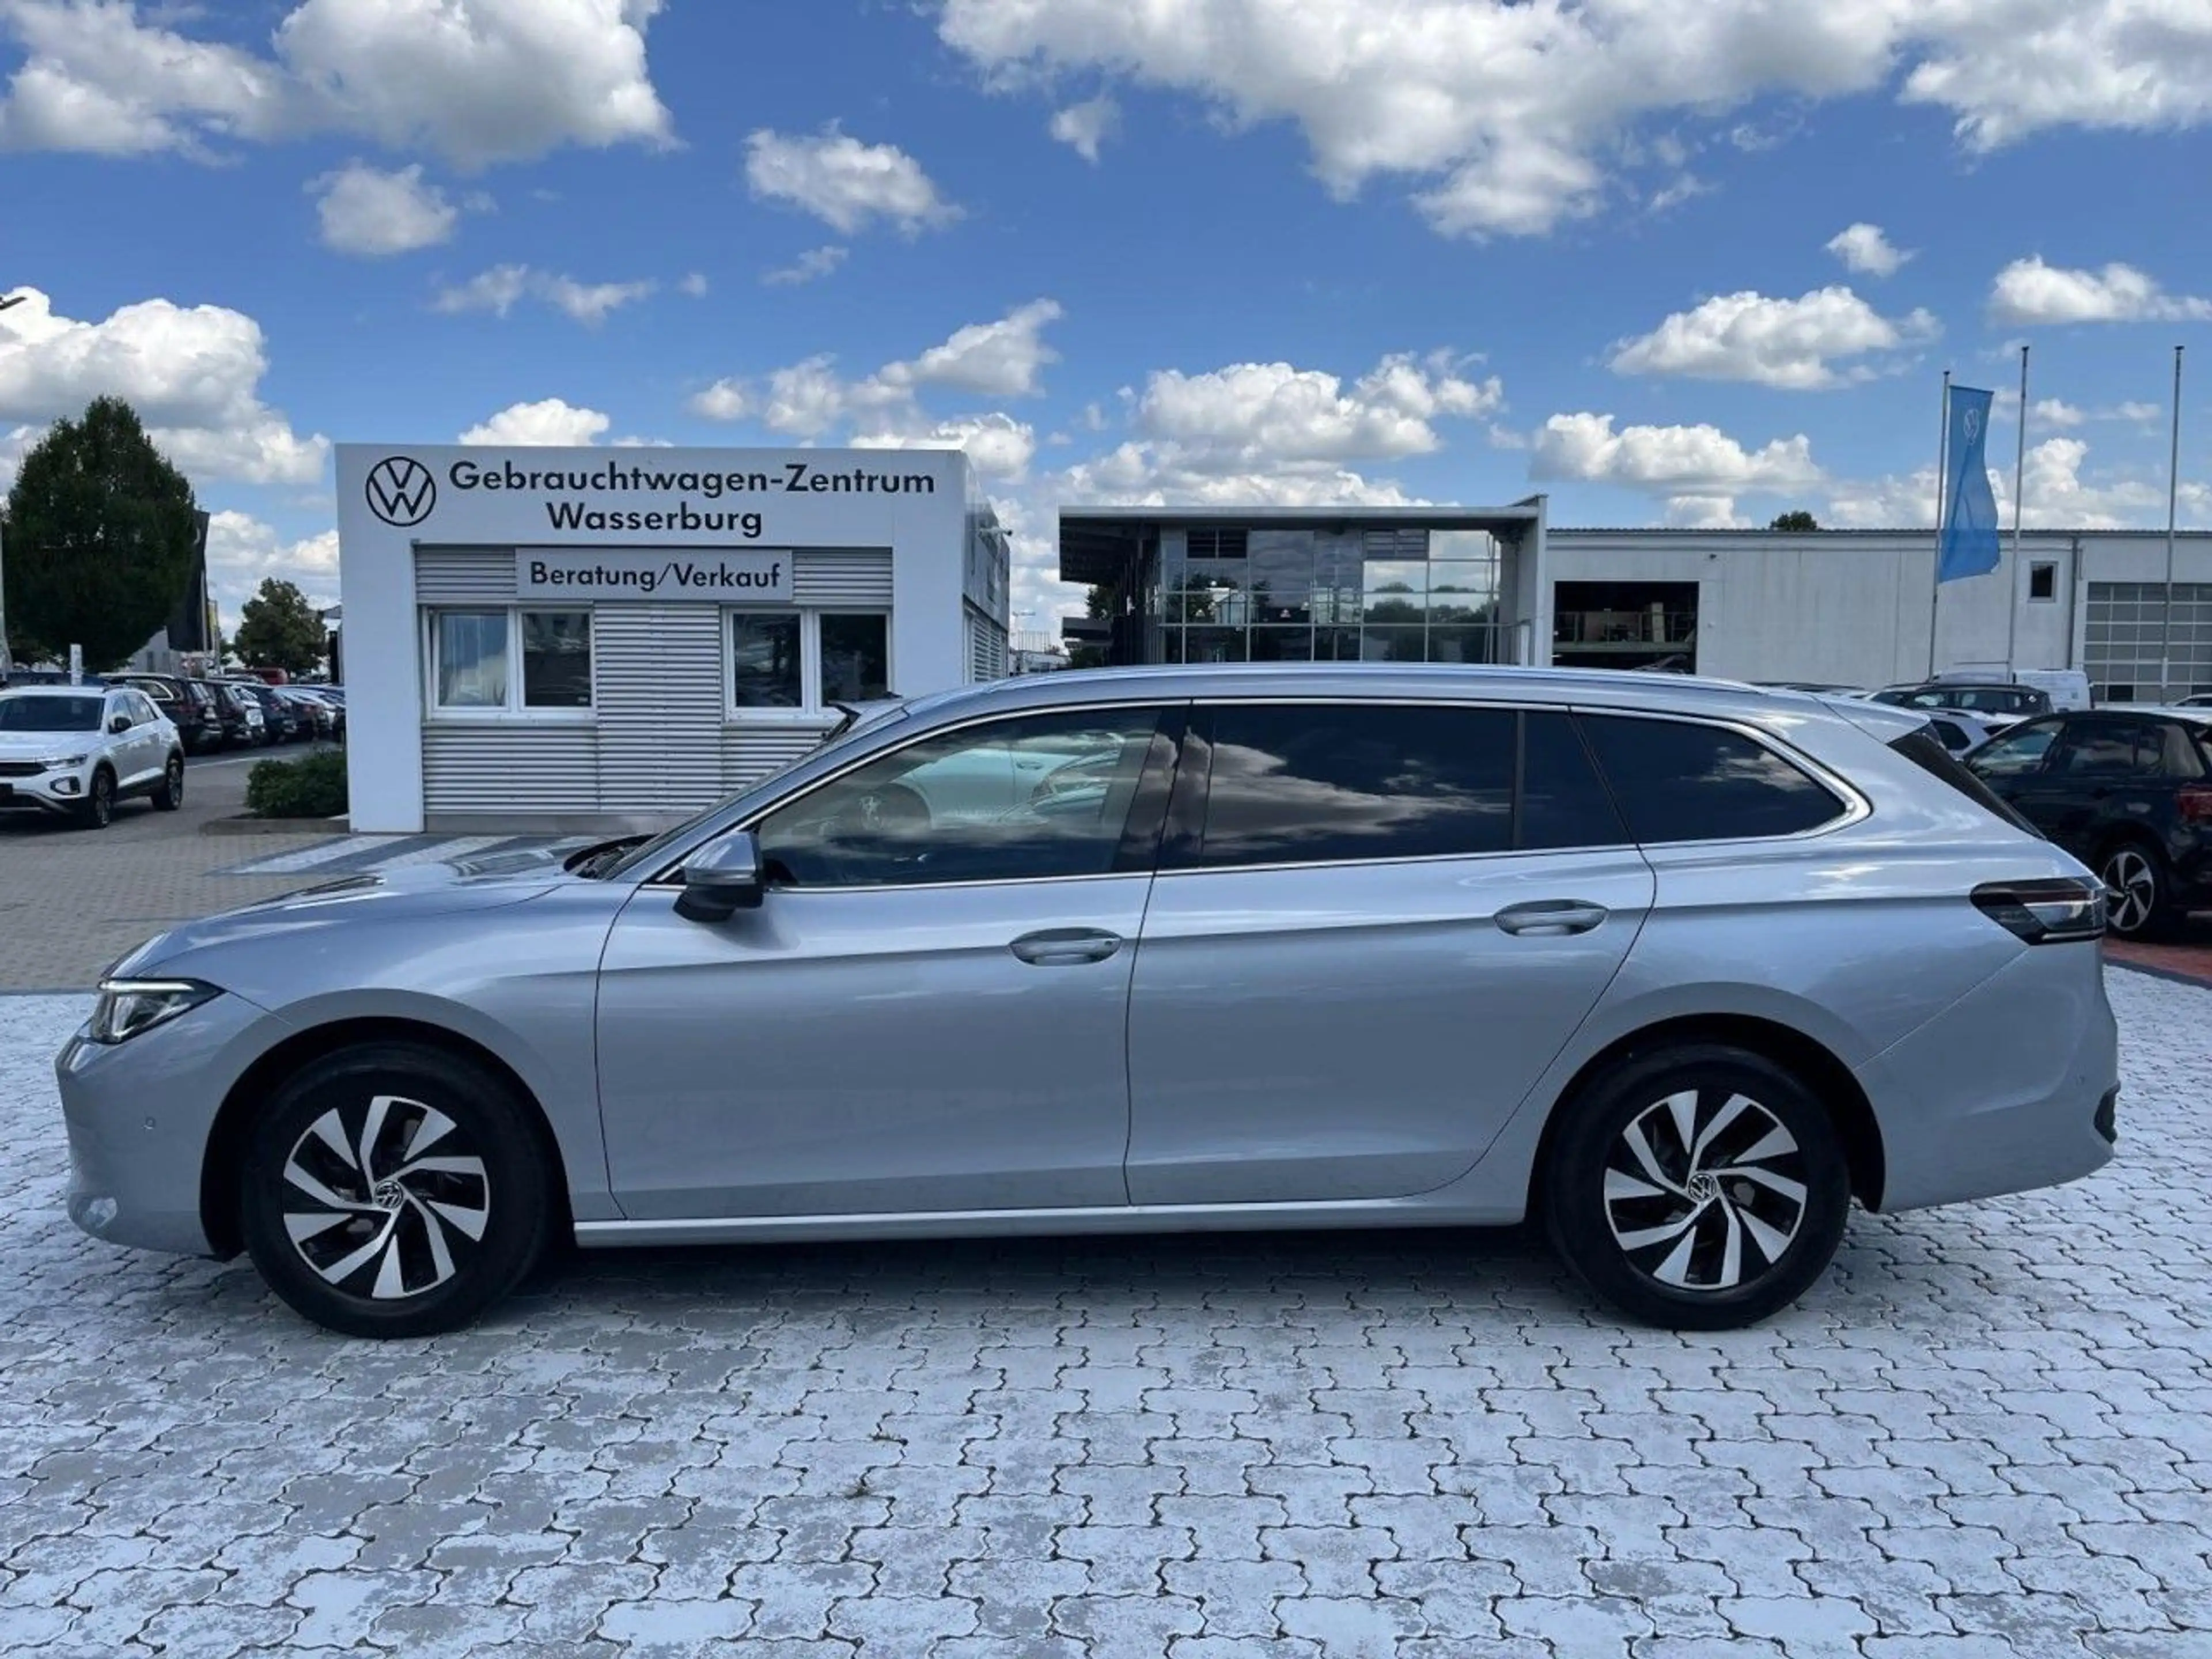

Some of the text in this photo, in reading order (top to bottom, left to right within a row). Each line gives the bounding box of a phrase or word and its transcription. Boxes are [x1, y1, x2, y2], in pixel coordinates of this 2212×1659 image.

[366, 457, 435, 527] VW
[449, 460, 934, 499] Gebrauchtwagen-Zentrum
[546, 501, 762, 539] Wasserburg
[530, 560, 781, 593] Beratung/Verkauf
